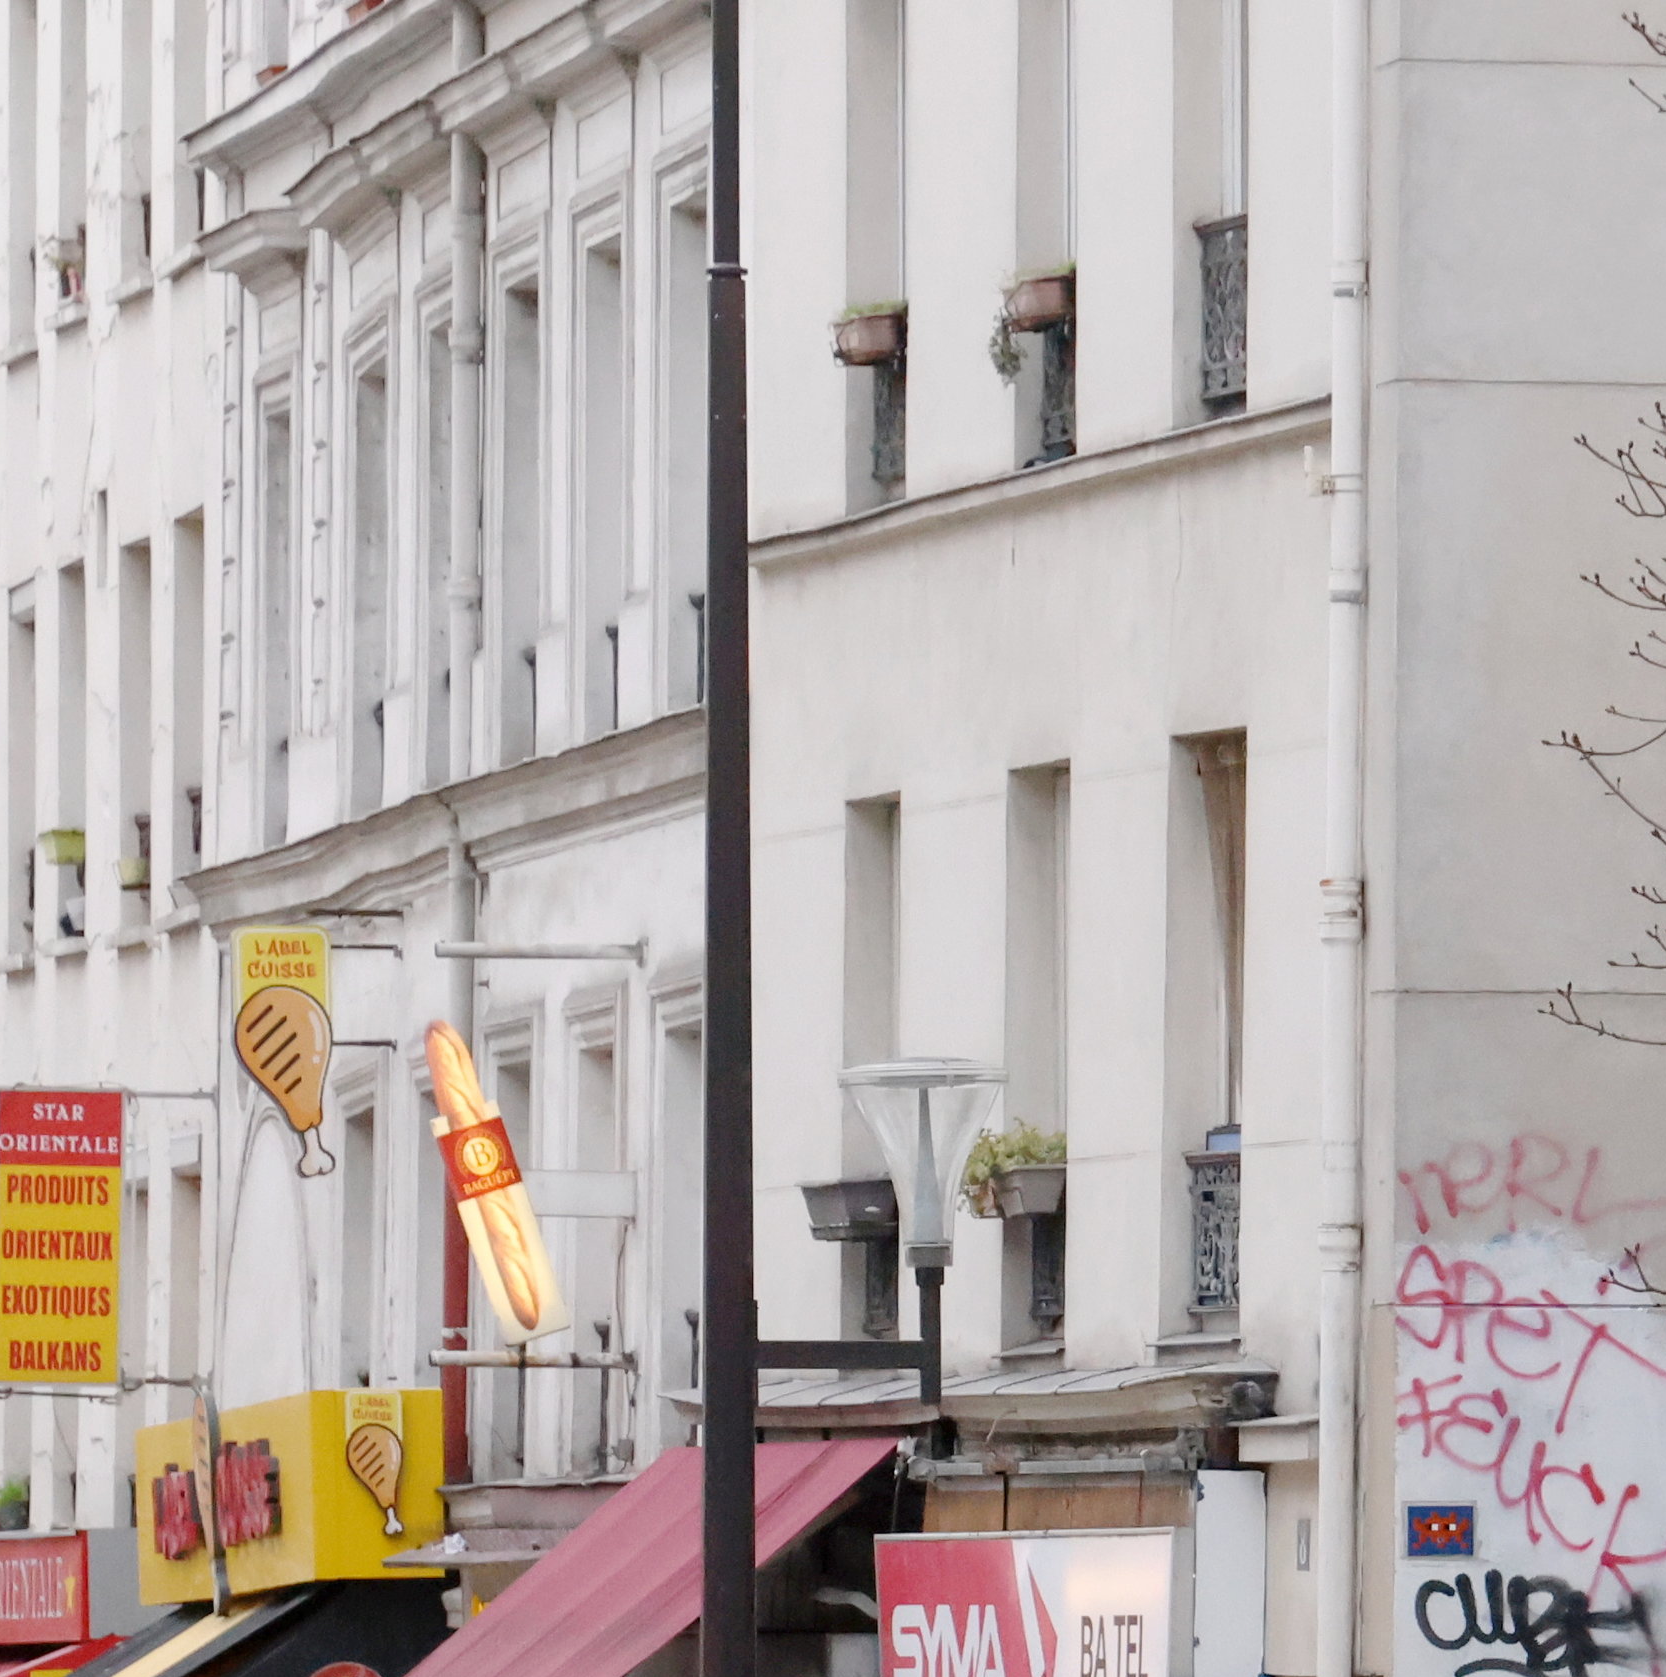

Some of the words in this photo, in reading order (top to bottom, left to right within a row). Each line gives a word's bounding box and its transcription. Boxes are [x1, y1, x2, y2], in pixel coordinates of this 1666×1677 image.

[255, 940, 312, 957] LABEL
[247, 961, 317, 979] CUISSE
[33, 1103, 85, 1122] STAR
[472, 1142, 491, 1168] B
[6, 1174, 110, 1206] PRODUITS
[1, 1229, 113, 1261] ORIENTAUX
[1, 1284, 112, 1320] EXOTIQUES
[8, 1339, 102, 1372] BALKANS
